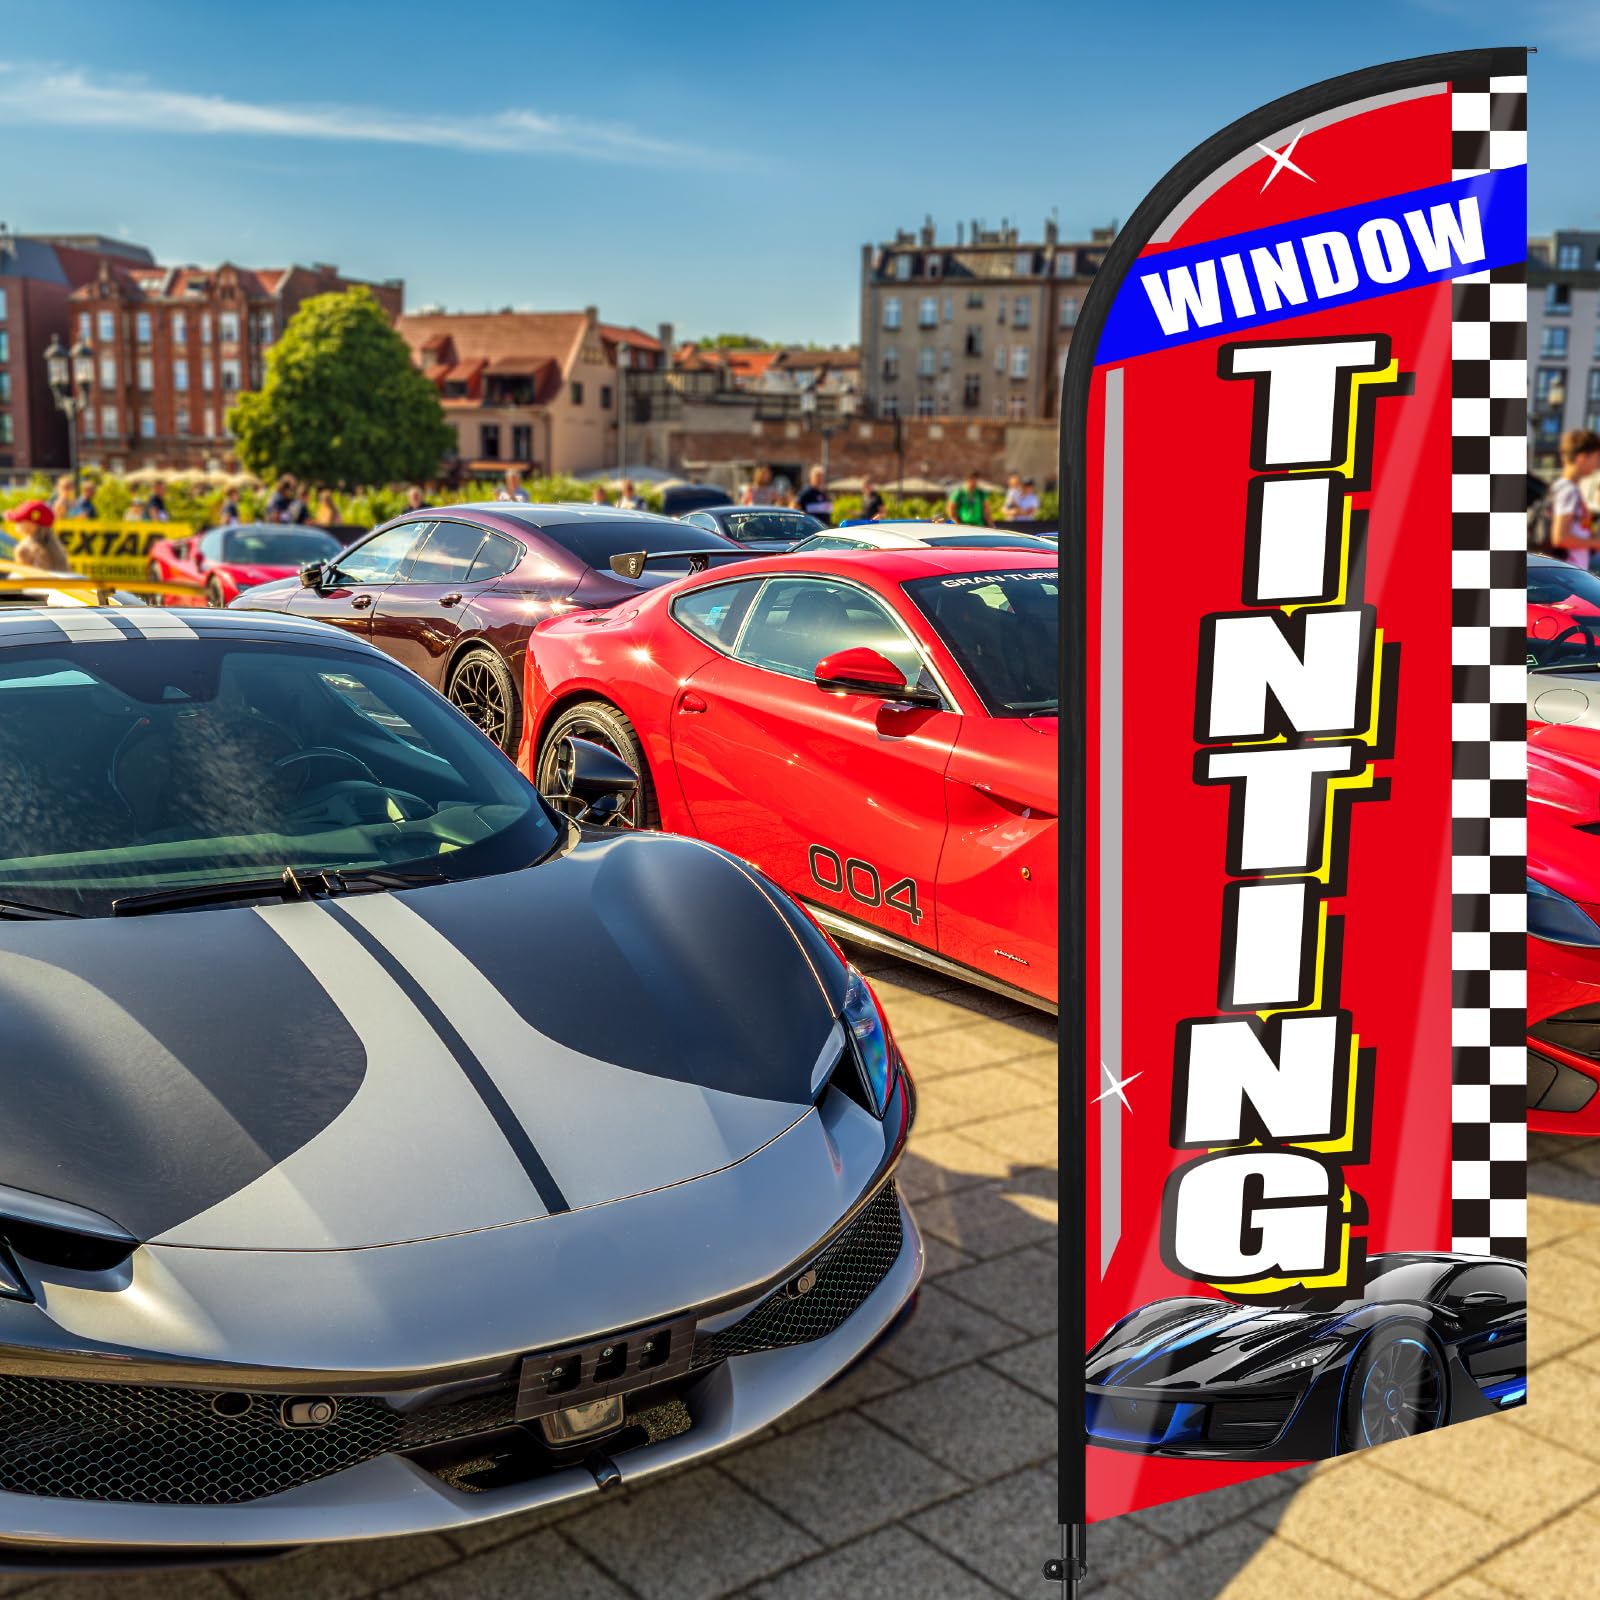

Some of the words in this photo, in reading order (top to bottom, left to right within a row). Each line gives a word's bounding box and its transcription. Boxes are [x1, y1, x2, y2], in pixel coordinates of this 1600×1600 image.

[1140, 195, 1486, 336] WINDOW
[941, 575, 1005, 588] GRAN
[1166, 335, 1395, 1290] TINTING
[808, 843, 923, 926] 004
